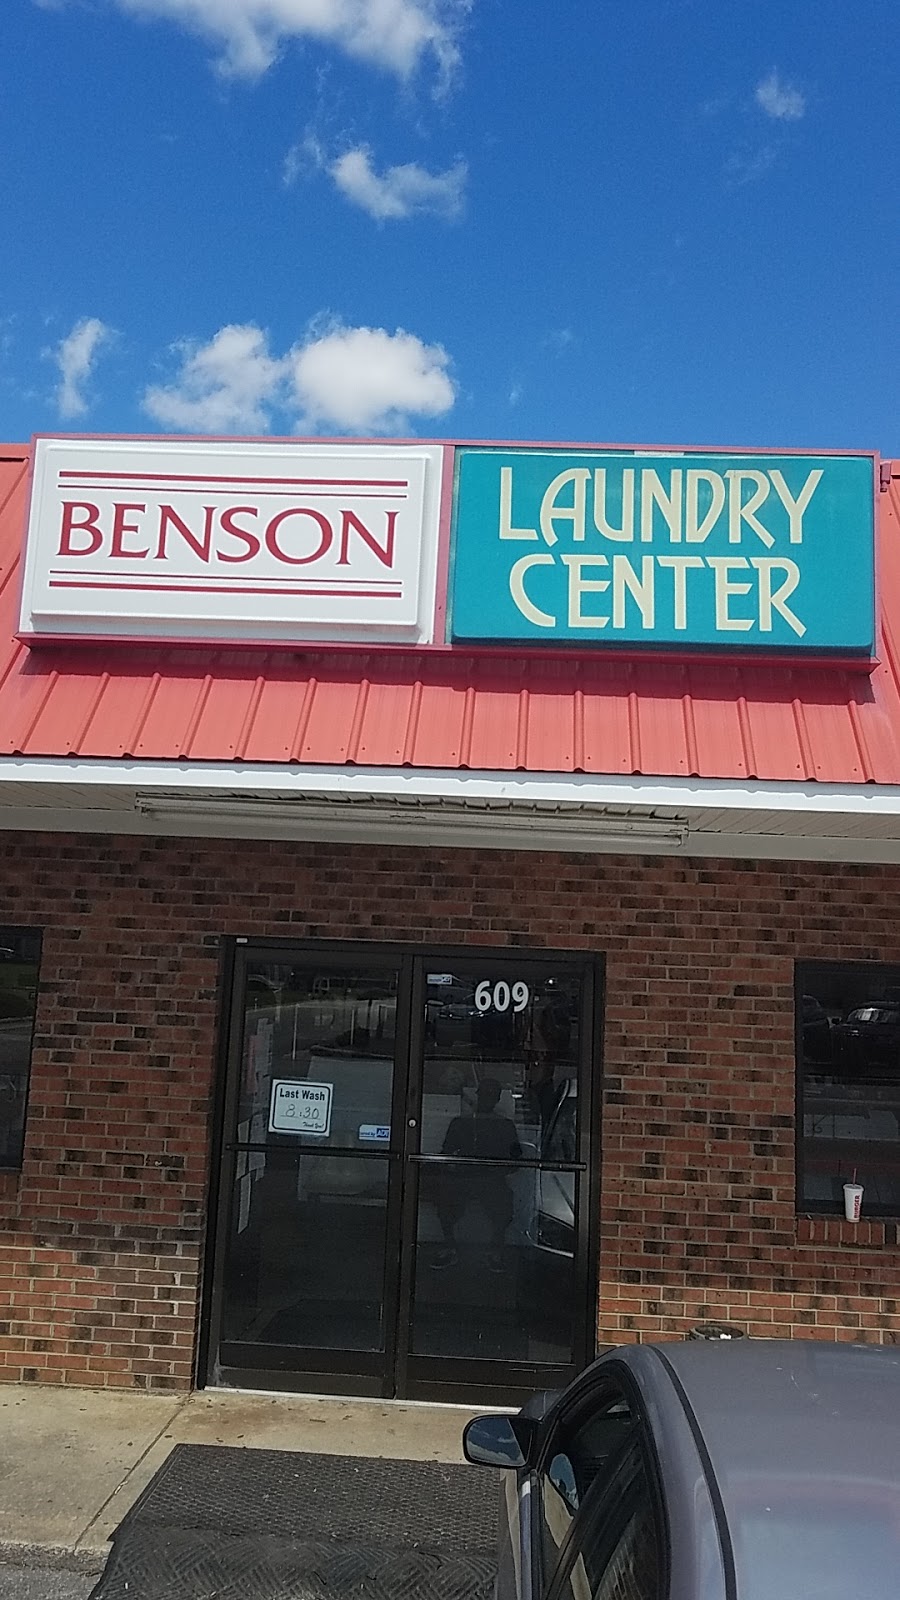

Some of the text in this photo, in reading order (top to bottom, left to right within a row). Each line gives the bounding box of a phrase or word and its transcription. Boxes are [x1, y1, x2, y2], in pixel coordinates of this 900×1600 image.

[499, 467, 823, 548] LAUNDRY
[56, 501, 399, 568] BENSON
[508, 553, 806, 637] CENTER
[475, 980, 529, 1012] 609
[280, 1088, 325, 1101] Last Wash
[286, 1103, 320, 1119] 8:30
